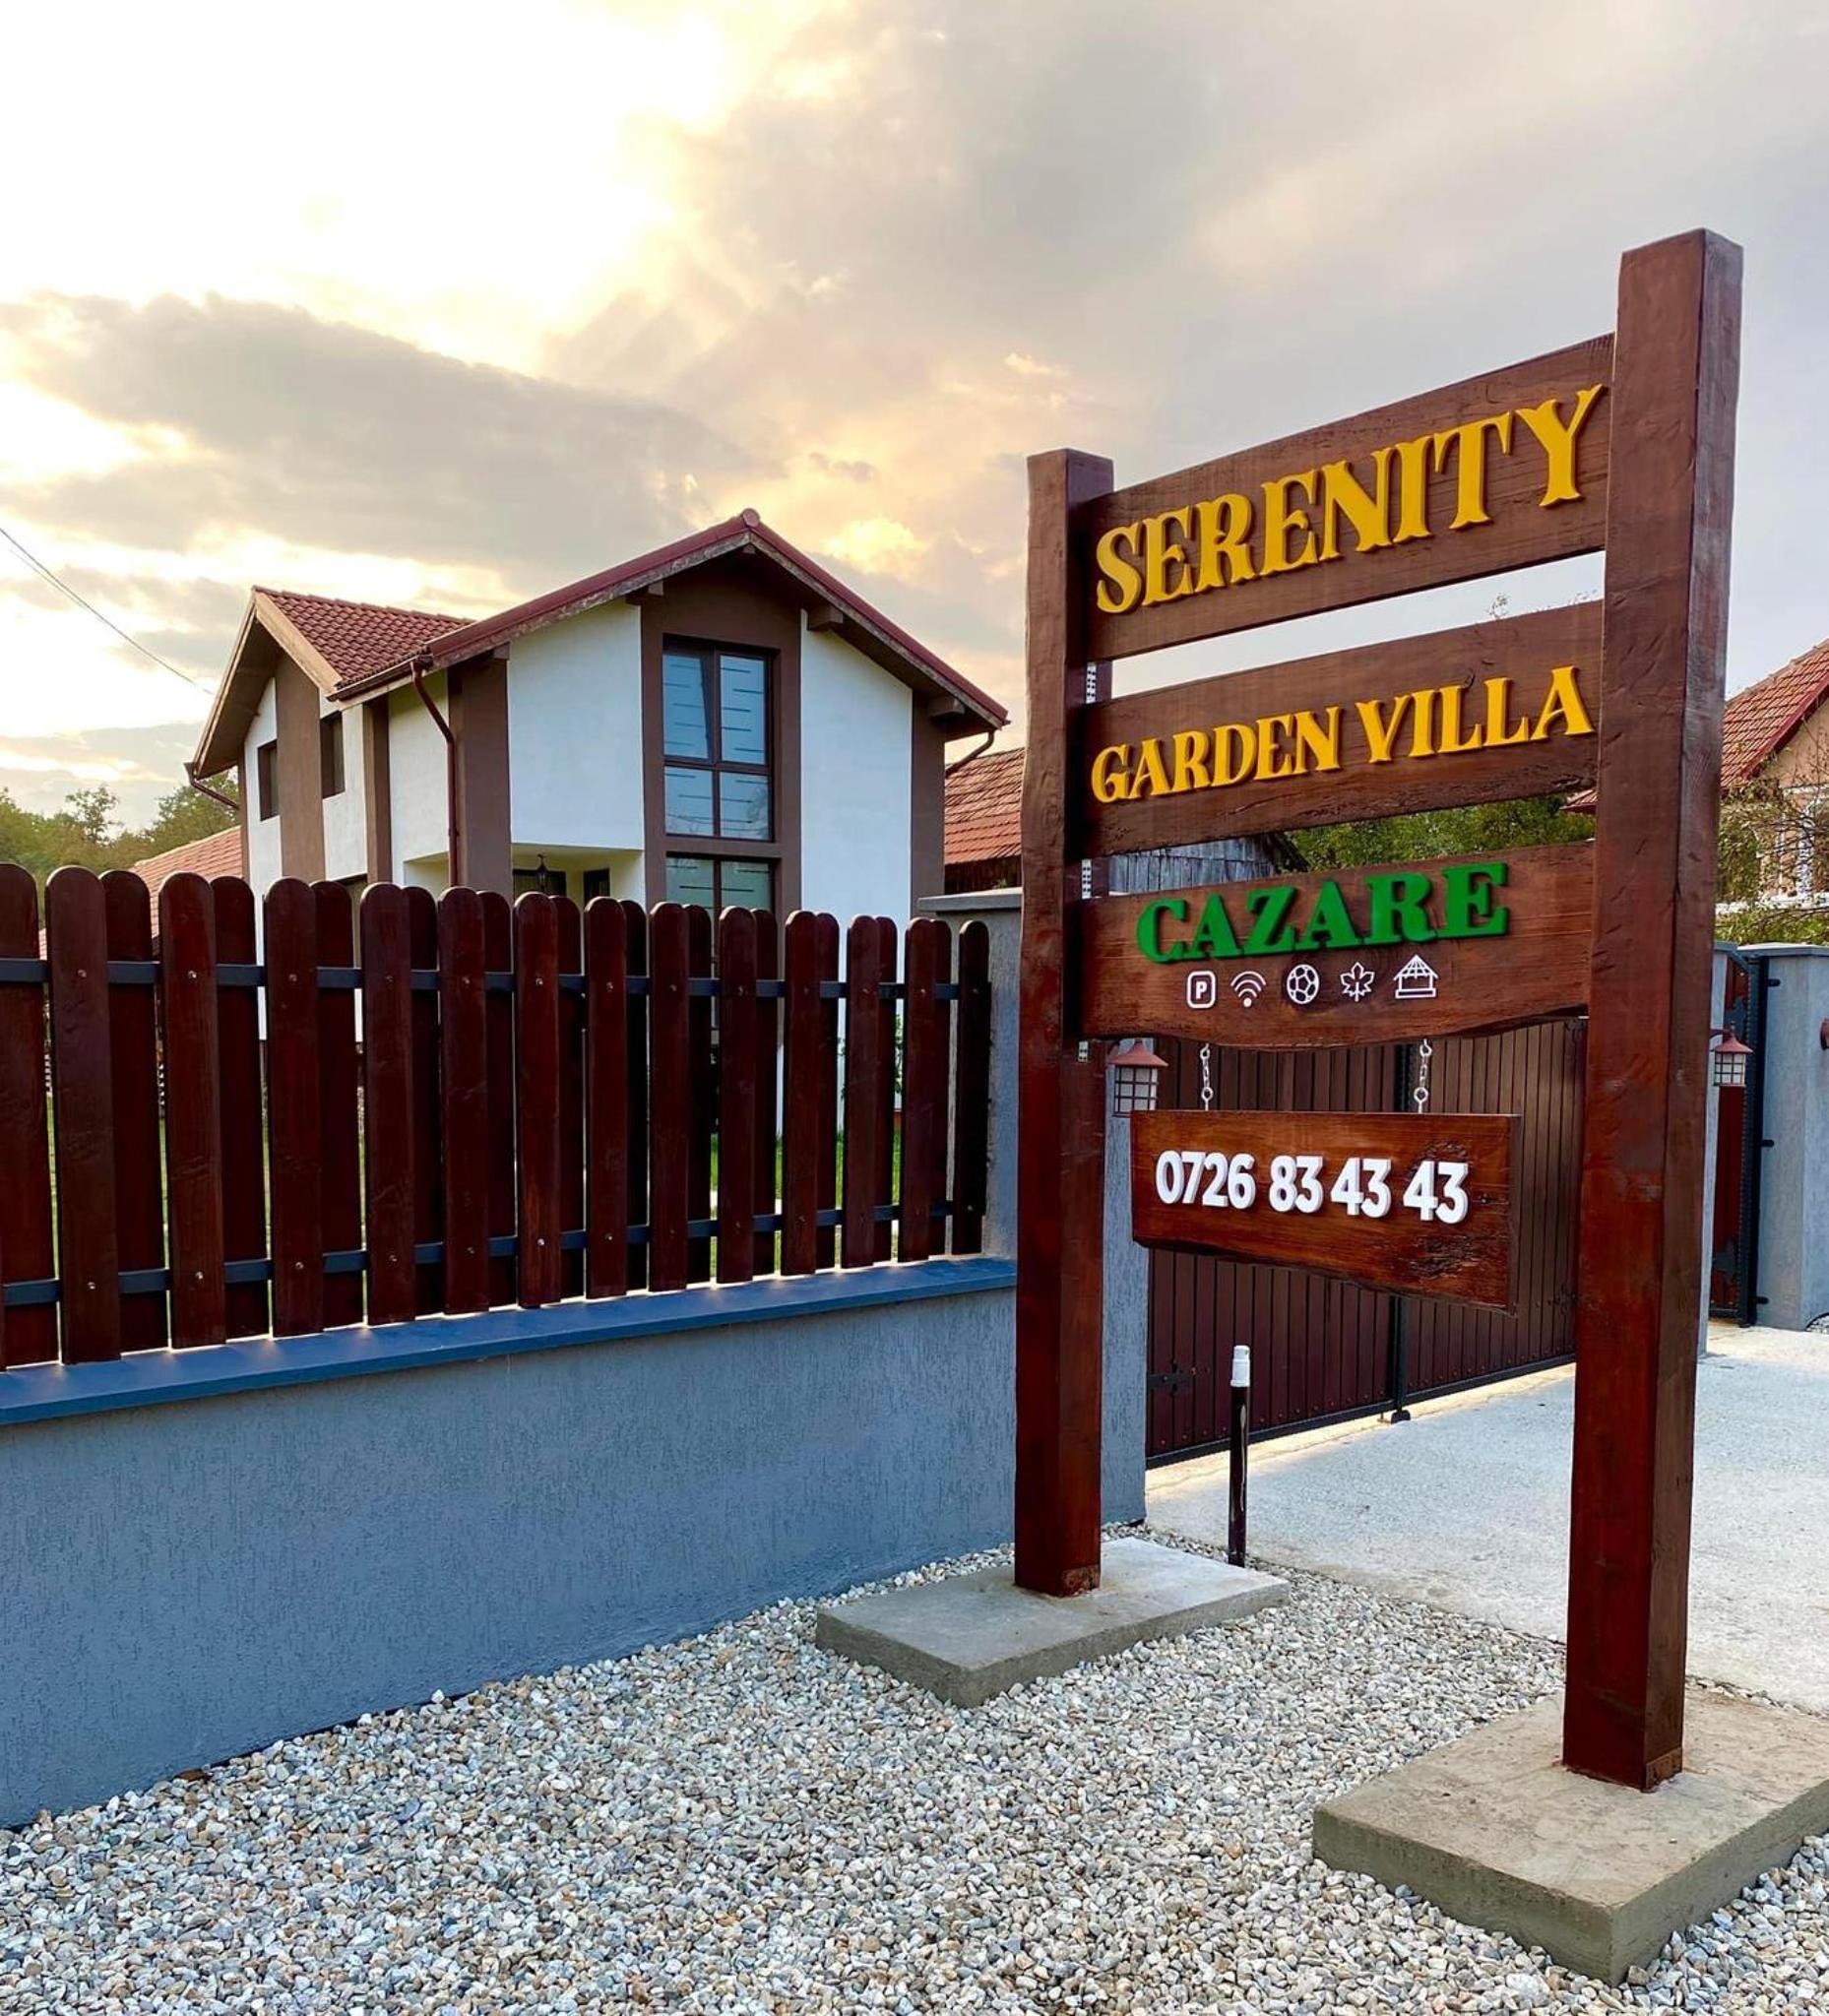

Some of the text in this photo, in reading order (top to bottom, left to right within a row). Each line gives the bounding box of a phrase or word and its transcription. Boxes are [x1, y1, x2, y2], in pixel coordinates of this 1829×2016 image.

[1096, 386, 1606, 612] SERENITY
[1091, 665, 1595, 802] GARDEN VILLA
[1136, 861, 1509, 965] CAZARE
[1155, 1150, 1470, 1225] 0726 83 43 43
